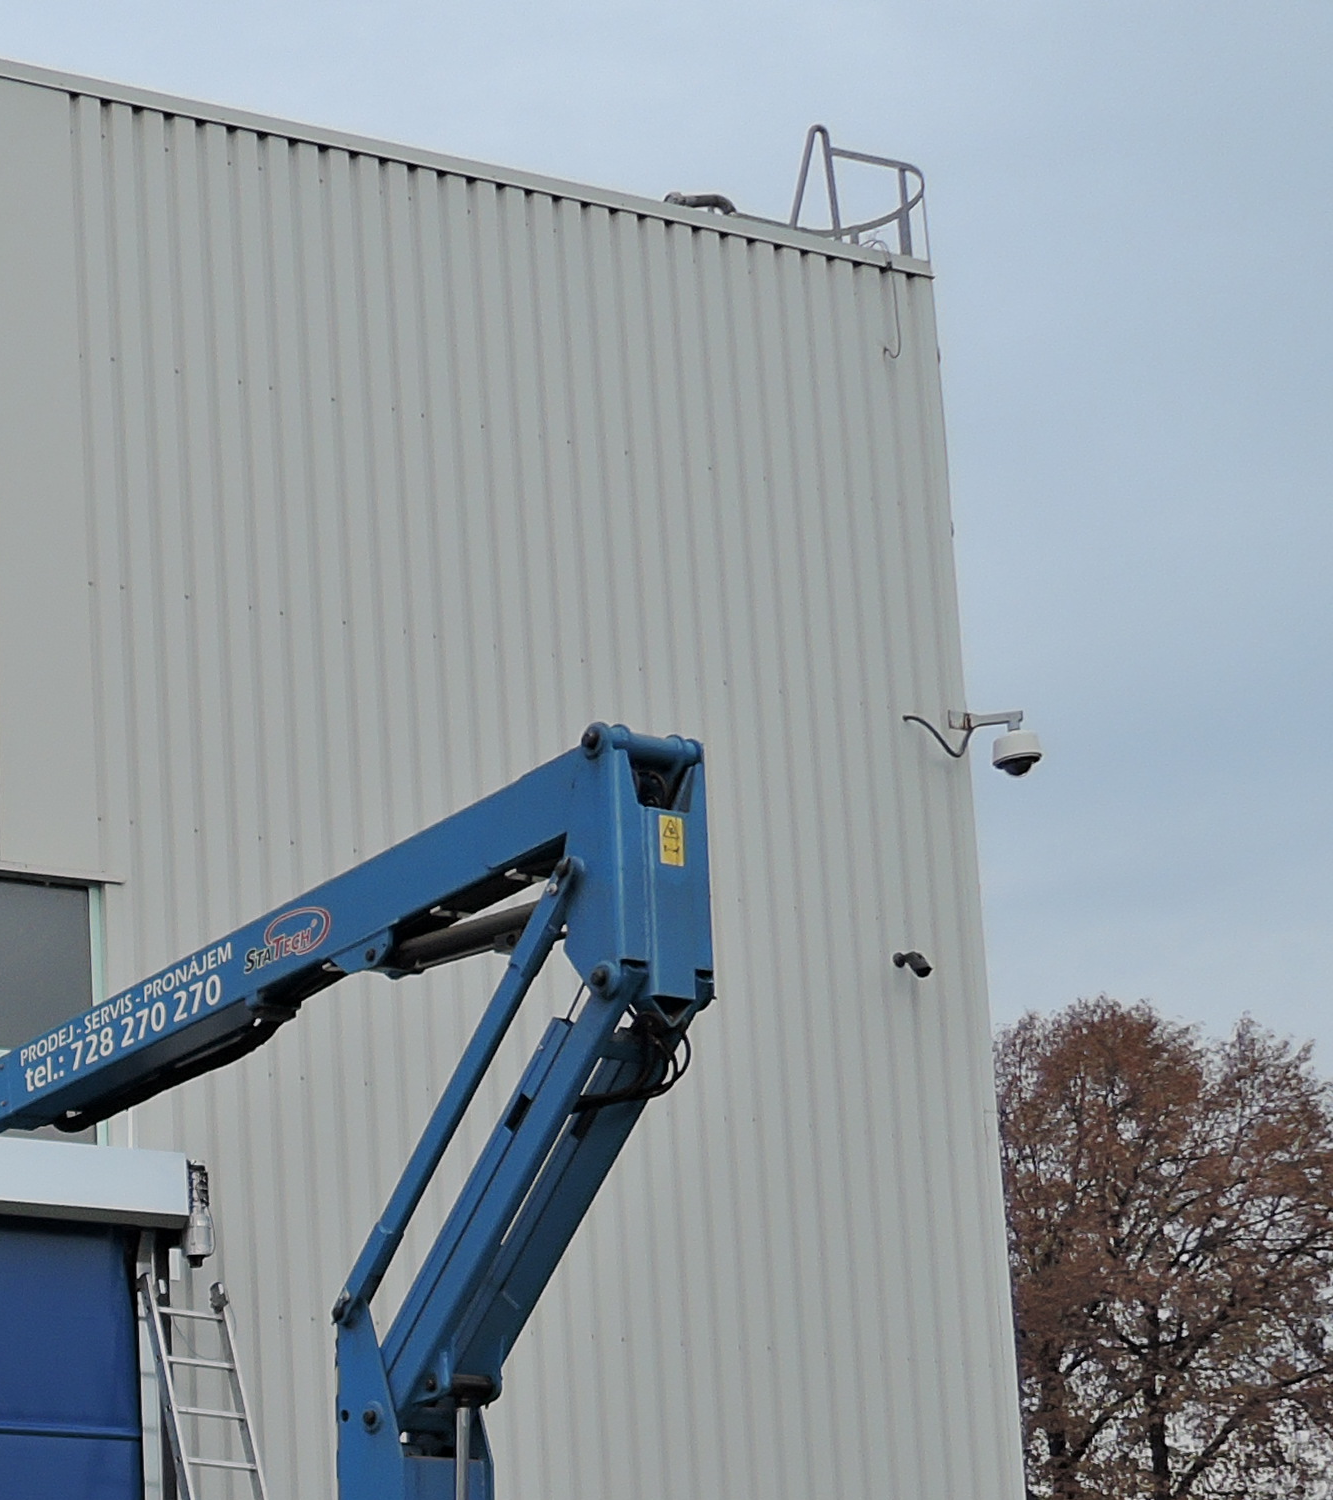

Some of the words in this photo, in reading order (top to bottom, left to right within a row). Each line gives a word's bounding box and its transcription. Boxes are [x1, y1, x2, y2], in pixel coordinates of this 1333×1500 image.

[20, 1027, 74, 1066] PRODEJ
[83, 994, 133, 1034] SERVIS
[144, 942, 232, 1002] PRONÁJEM
[25, 1055, 65, 1092] tel.:
[71, 1027, 113, 1071] 728
[120, 1002, 166, 1048] 270
[173, 974, 222, 1022] 270
